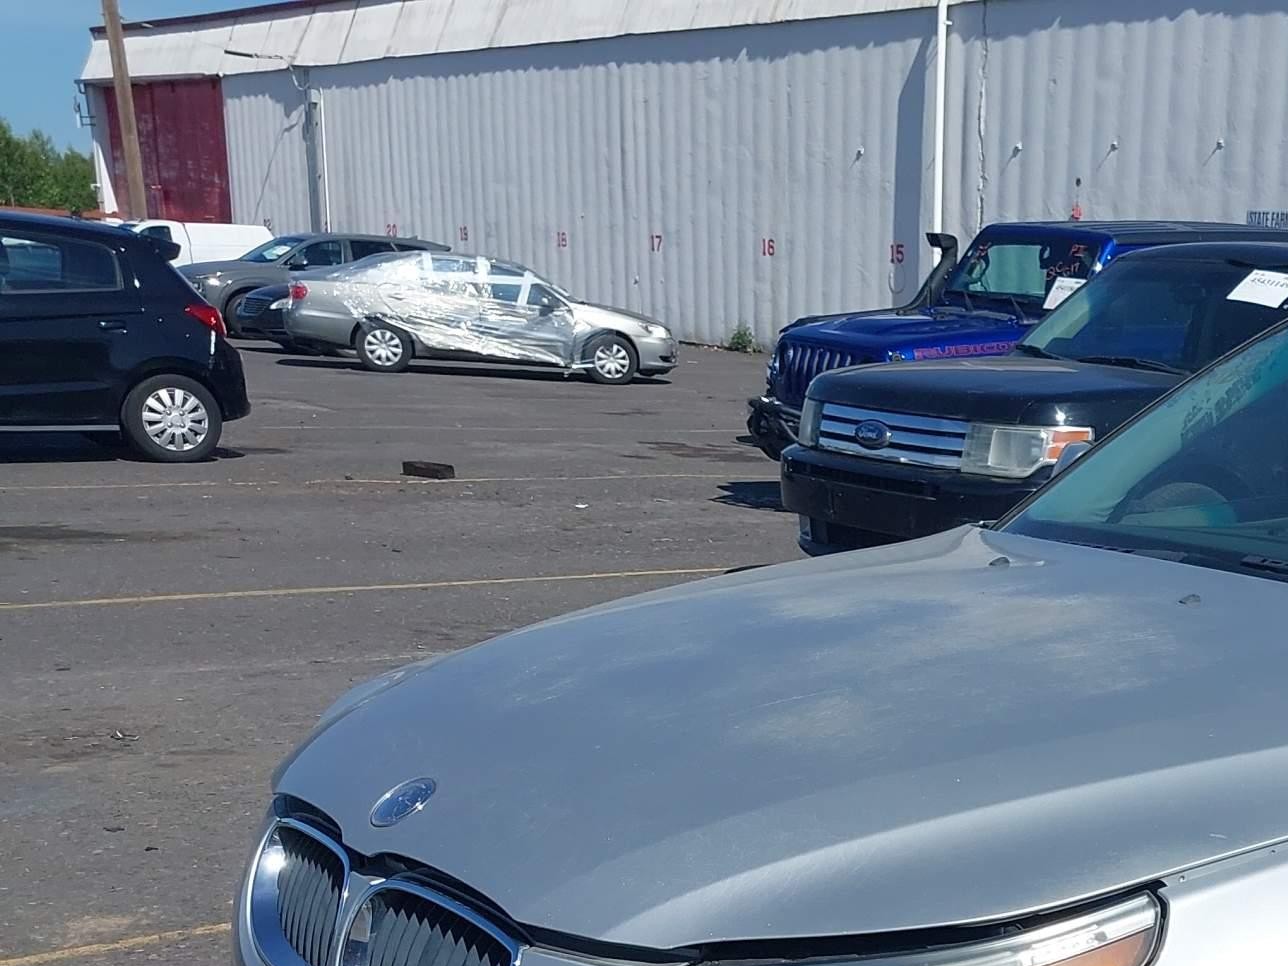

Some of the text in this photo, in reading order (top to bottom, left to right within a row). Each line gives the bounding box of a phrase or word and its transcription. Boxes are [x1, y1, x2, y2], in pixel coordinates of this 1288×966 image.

[1249, 211, 1269, 228] STATE
[557, 231, 567, 248] 18
[650, 234, 662, 252] 17
[762, 238, 775, 256] 16
[890, 244, 905, 265] 15
